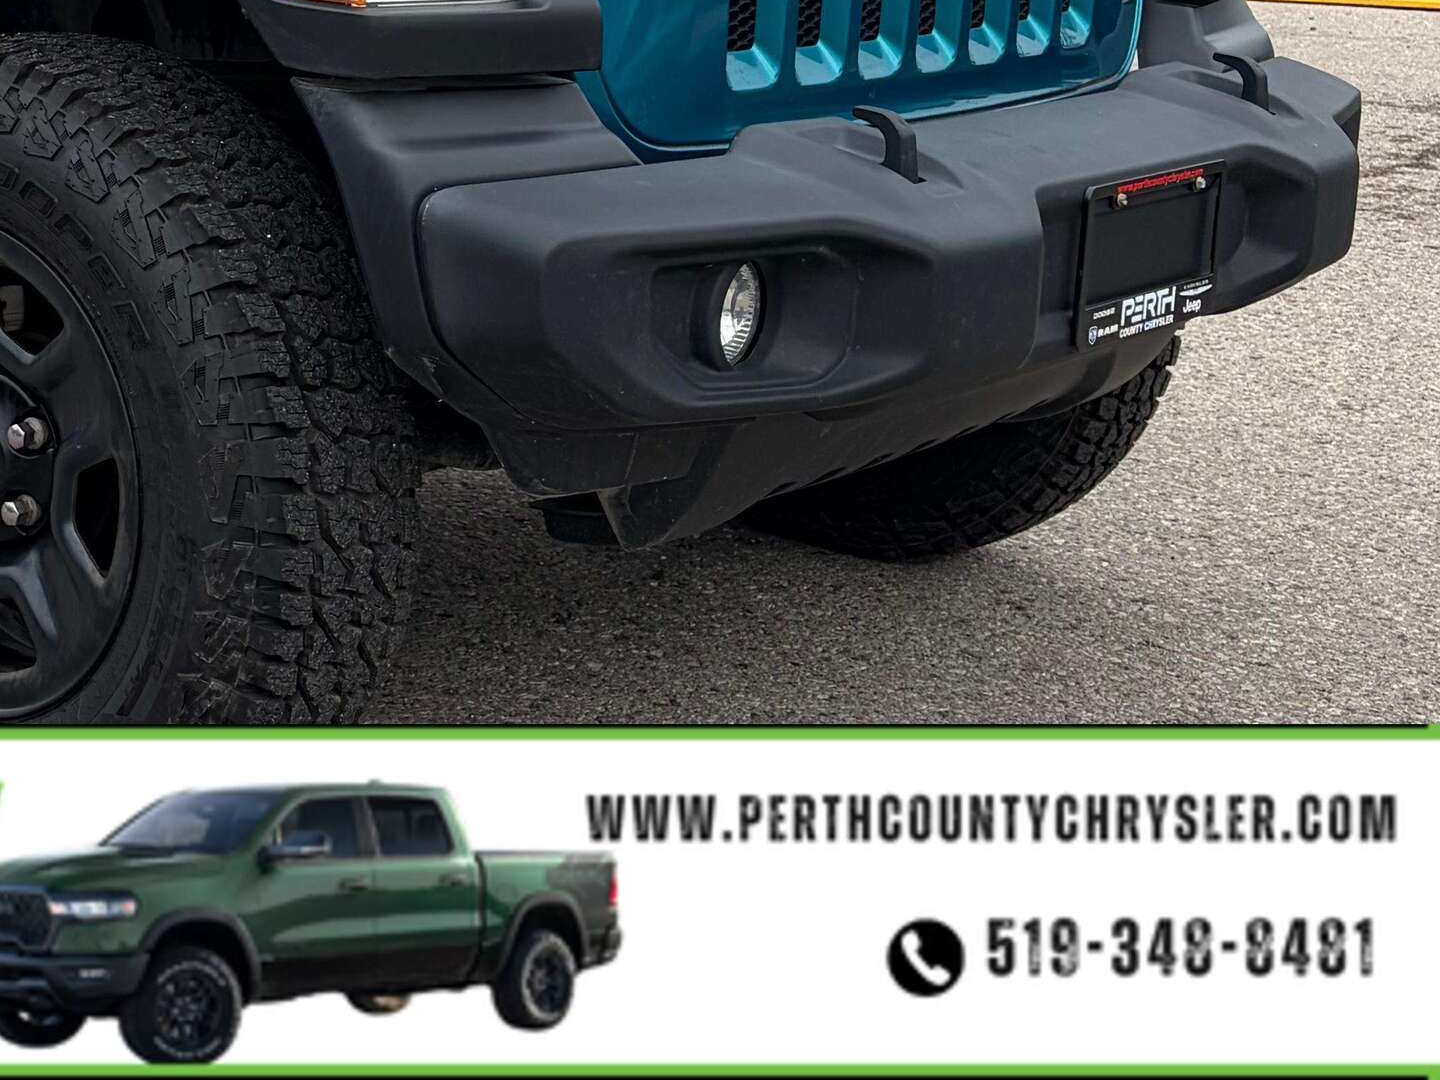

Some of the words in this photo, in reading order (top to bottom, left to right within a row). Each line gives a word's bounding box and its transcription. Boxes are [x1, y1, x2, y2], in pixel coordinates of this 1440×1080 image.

[1120, 285, 1177, 327] PERTH
[1182, 298, 1202, 314] Jeep
[1098, 324, 1119, 338] RAM
[1119, 323, 1144, 339] COUNTY
[1144, 314, 1174, 332] CHRYSLER
